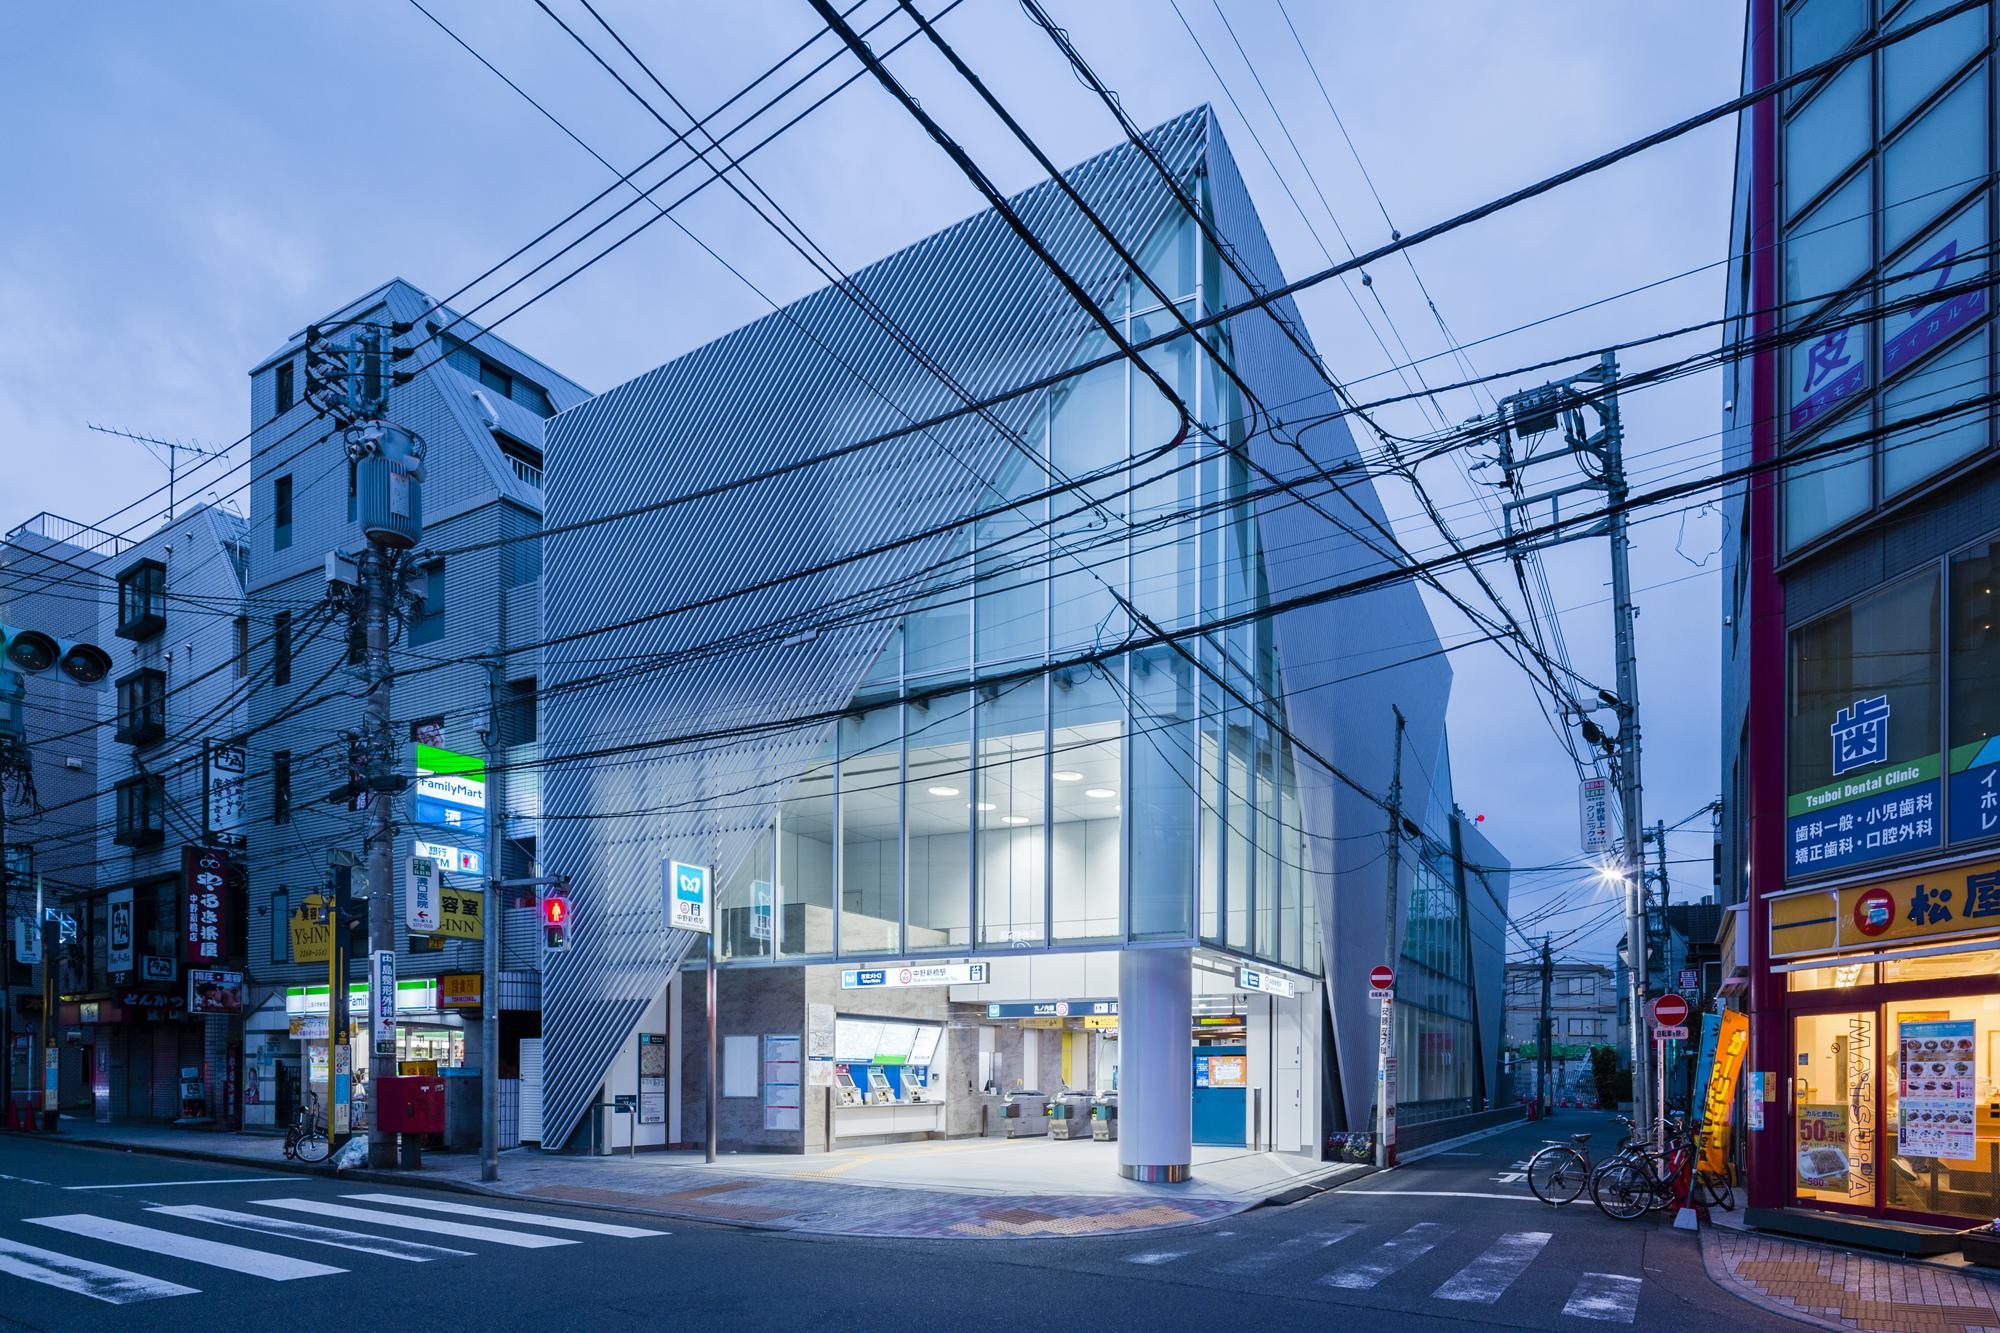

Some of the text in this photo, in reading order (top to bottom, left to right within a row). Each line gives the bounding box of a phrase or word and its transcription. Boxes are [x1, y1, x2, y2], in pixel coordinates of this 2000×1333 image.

[1831, 694, 1890, 776] 歯
[421, 777, 482, 799] FamilyMart
[1806, 767, 1920, 808] Tsuboi Dental Clinic
[444, 809, 461, 827] 酒
[1586, 805, 1597, 838] クリニック
[1595, 800, 1606, 828] 中野坂上
[1795, 793, 1933, 843] 歯科一般・小児歯科
[217, 833, 241, 844] 2F
[429, 845, 447, 858] 銀行
[1795, 818, 1933, 865] 矯正歯科・口腔外科
[442, 896, 479, 917] 容室
[1906, 870, 2000, 926] 松屋
[381, 955, 393, 1016] 中島整形外科
[1656, 1030, 1687, 1038] 自転車を除く
